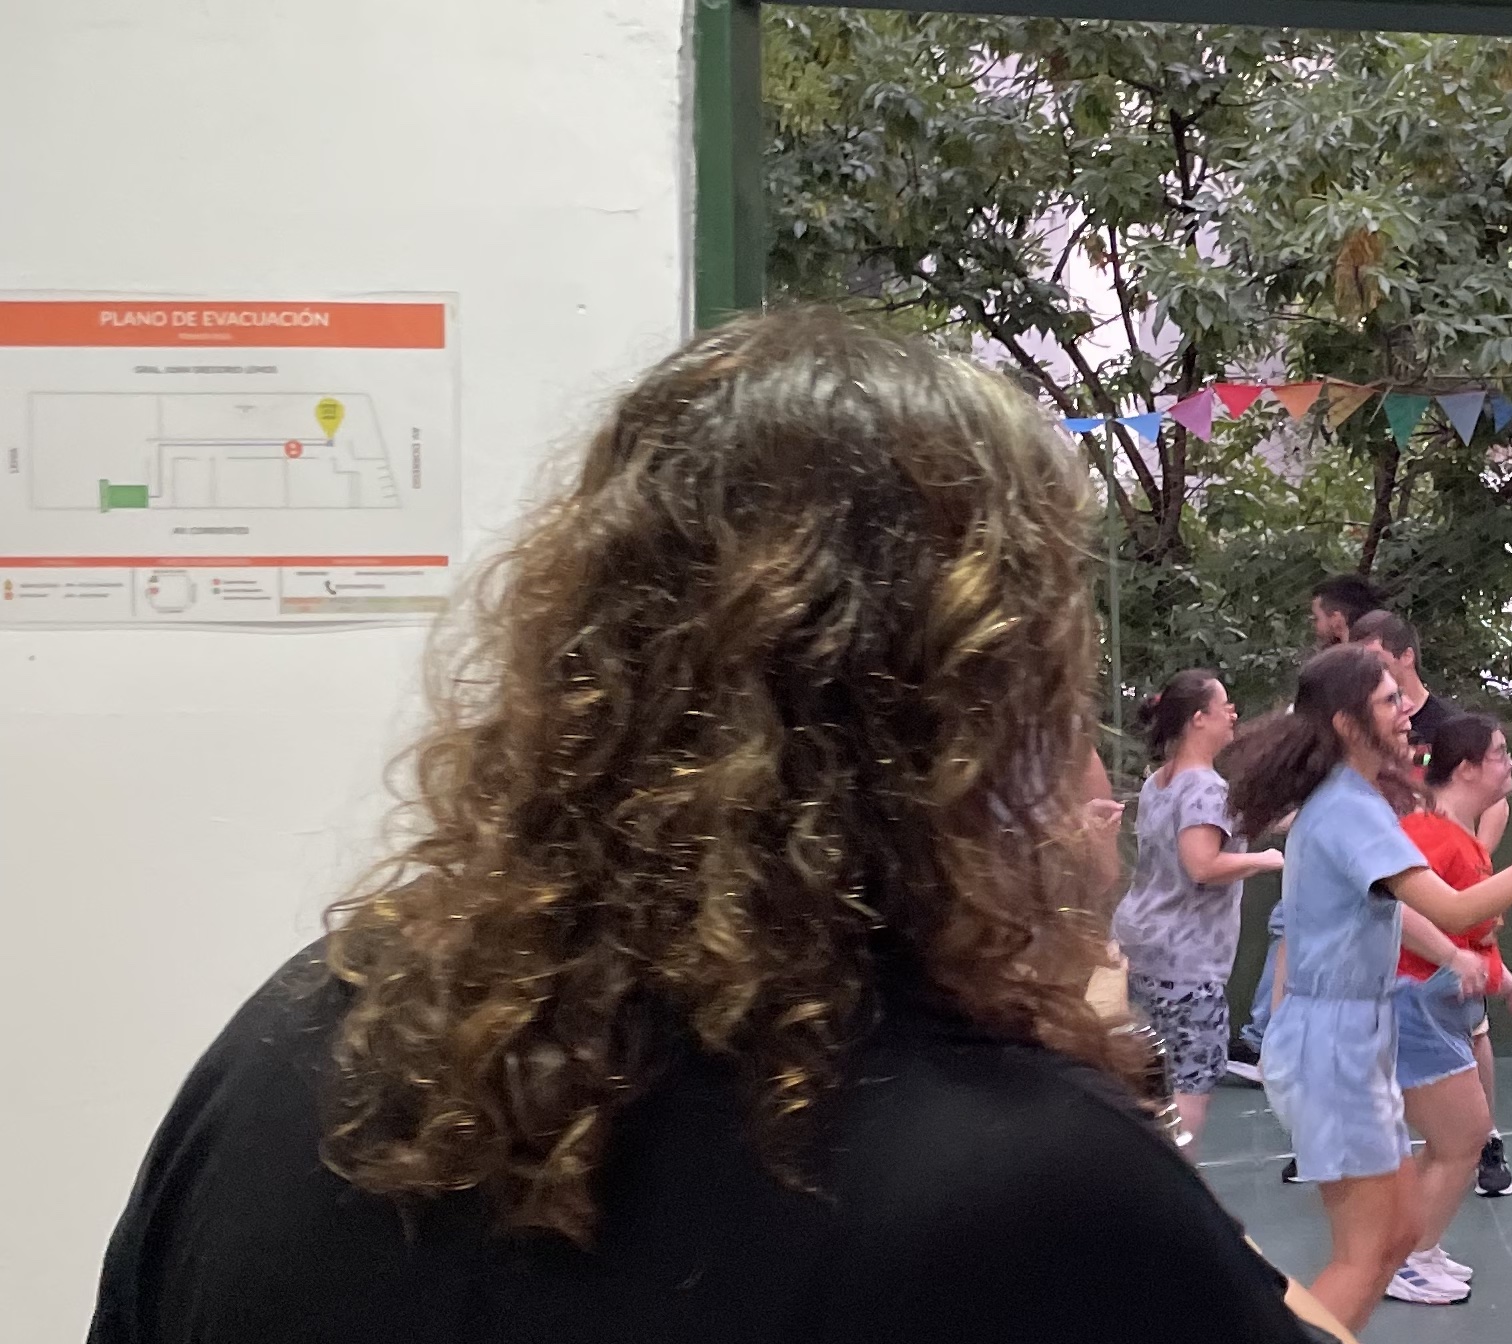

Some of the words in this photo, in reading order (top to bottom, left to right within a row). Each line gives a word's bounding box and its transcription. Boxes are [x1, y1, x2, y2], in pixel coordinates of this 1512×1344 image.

[100, 311, 167, 327] PLANO
[172, 311, 197, 327] DE
[203, 308, 329, 327] EVACUACIÓN
